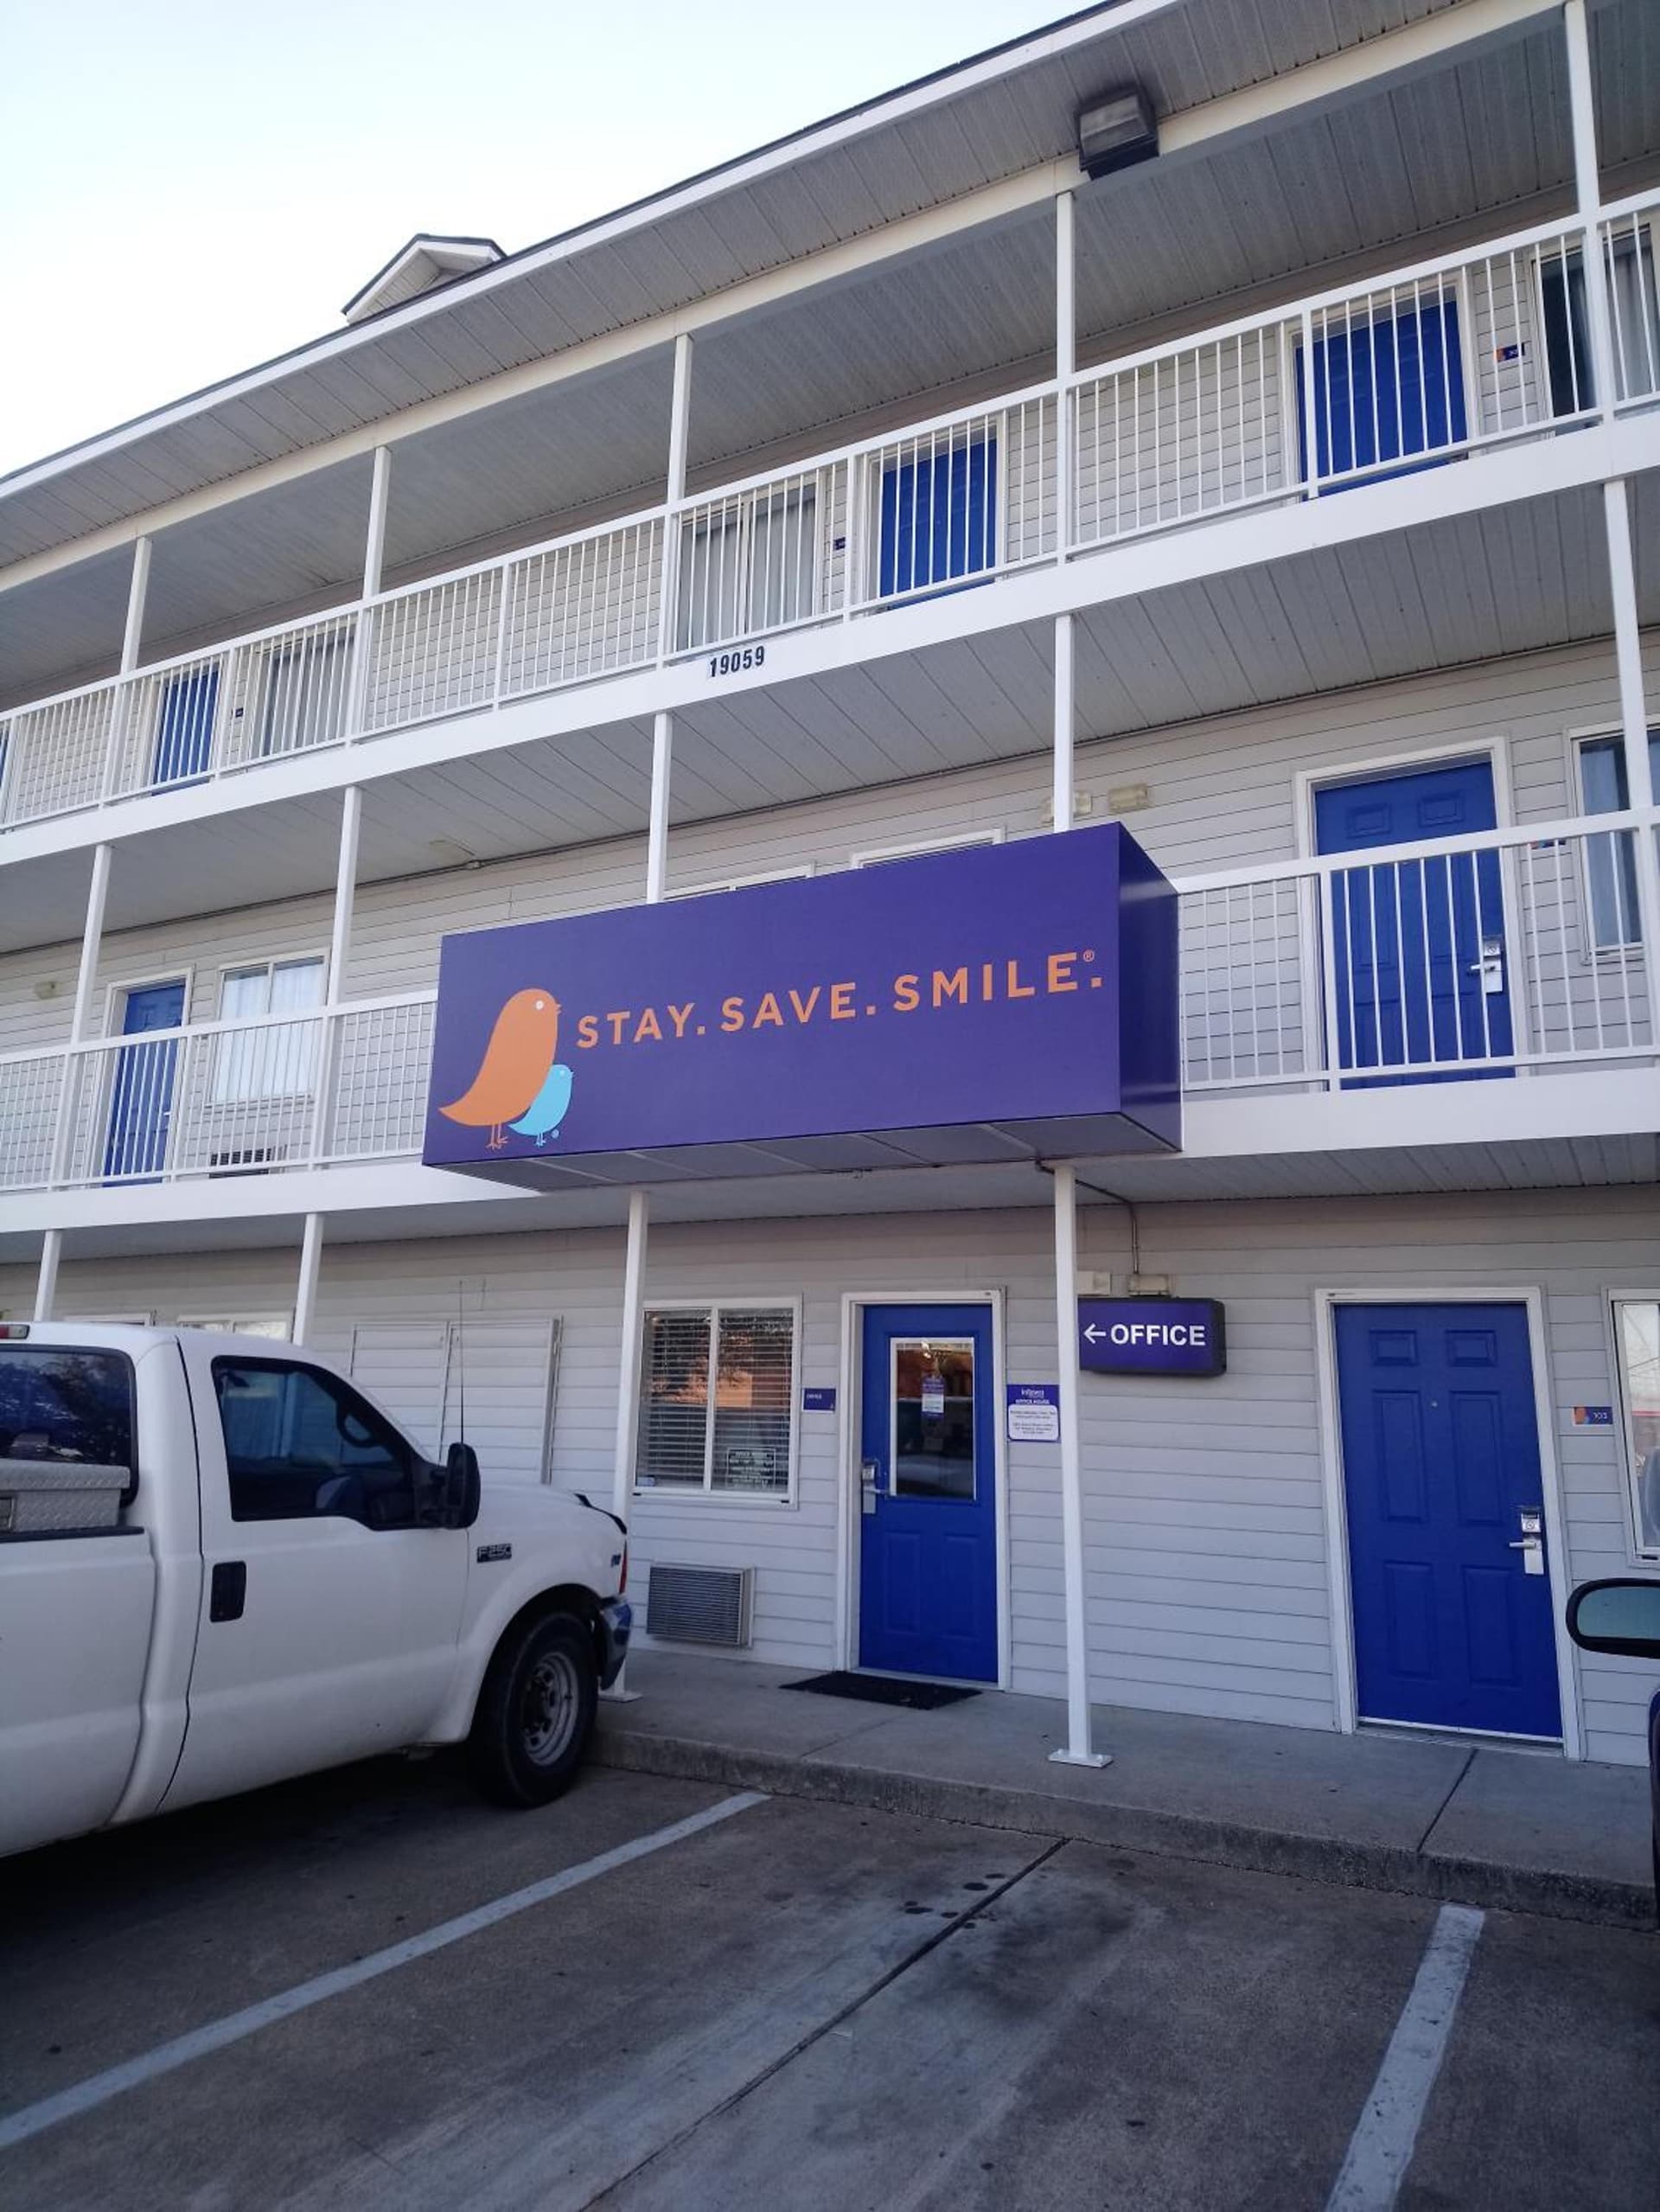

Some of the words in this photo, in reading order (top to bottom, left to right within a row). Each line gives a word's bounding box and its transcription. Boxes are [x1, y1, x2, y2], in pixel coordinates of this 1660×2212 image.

[710, 646, 764, 677] 19059
[577, 1002, 706, 1048] STAY.
[720, 981, 876, 1032] SAVE.
[1110, 1324, 1206, 1346] OFFICE
